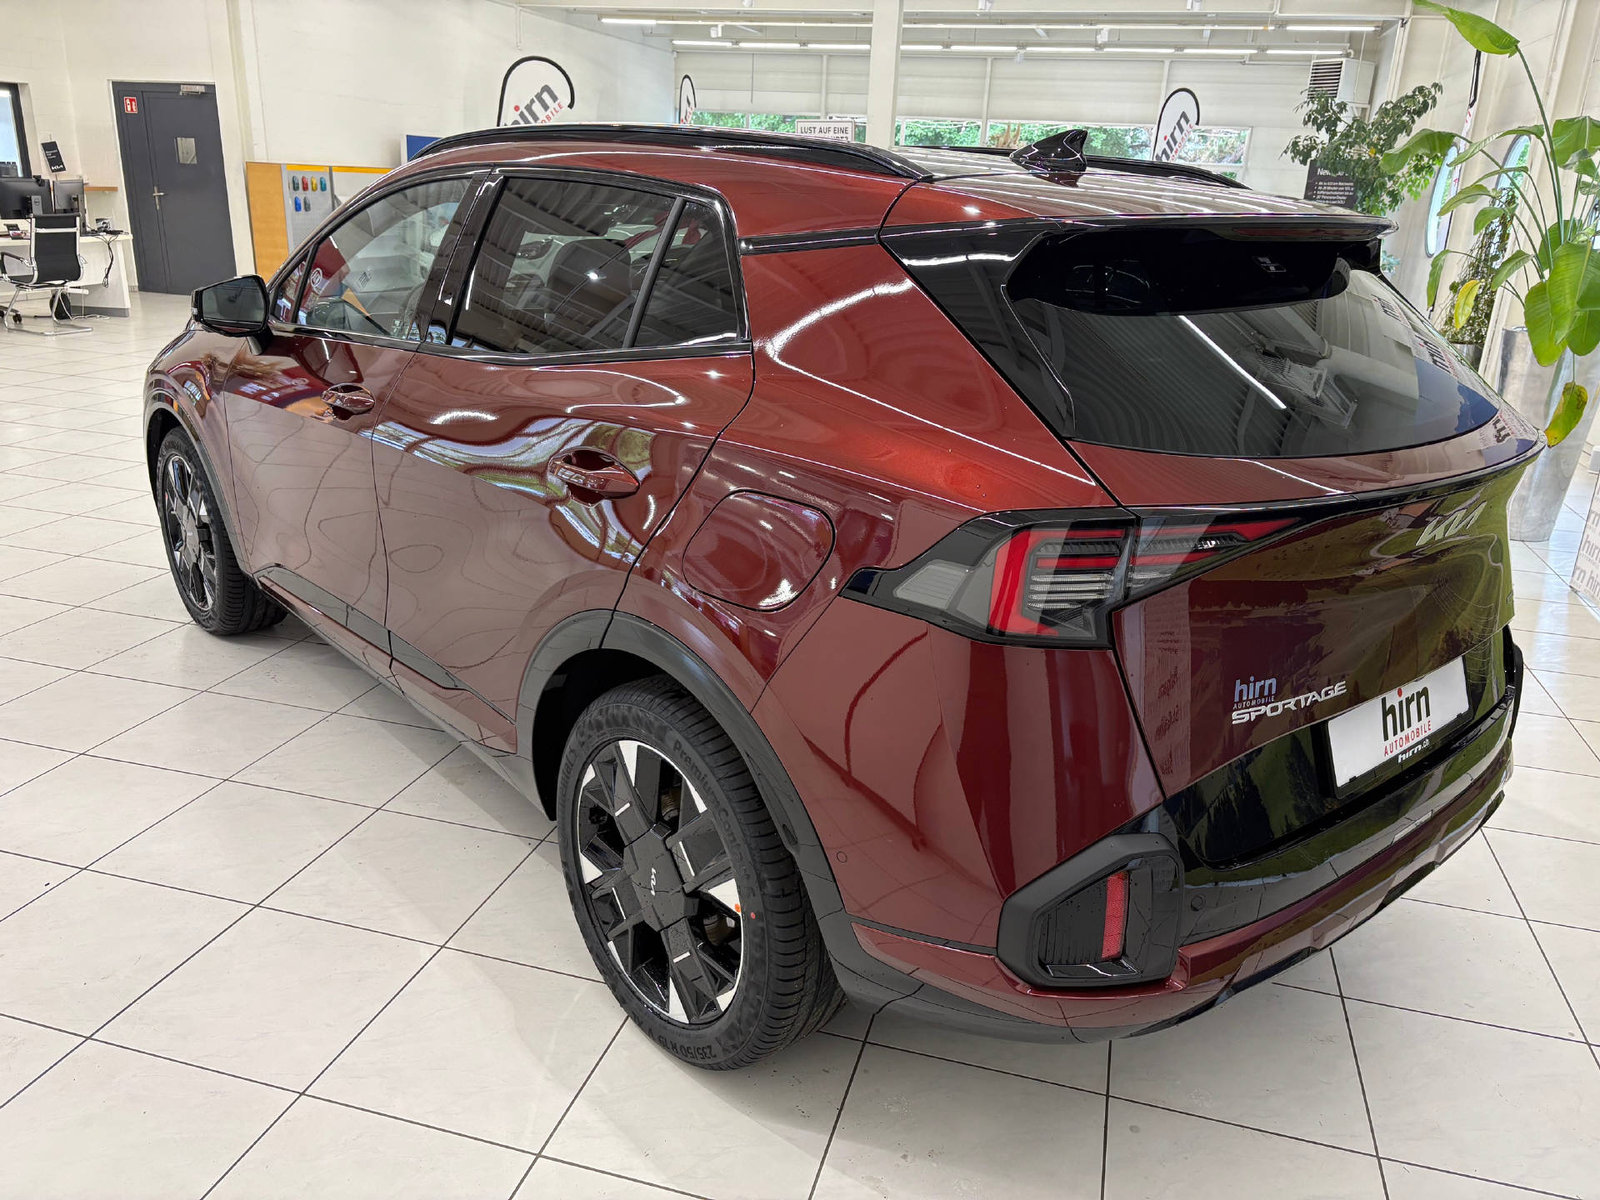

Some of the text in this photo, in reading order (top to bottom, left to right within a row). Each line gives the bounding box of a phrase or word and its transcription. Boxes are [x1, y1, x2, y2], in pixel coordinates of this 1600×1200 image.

[800, 126, 849, 135] LUST AUF EINE
[1234, 676, 1277, 702] hirn
[1231, 680, 1348, 725] SPORTAGE
[1233, 695, 1275, 710] AUTOMOBILE
[1381, 686, 1431, 742] hirn
[1384, 719, 1432, 757] AUTOMOBILE
[680, 1043, 717, 1060] 235/50
